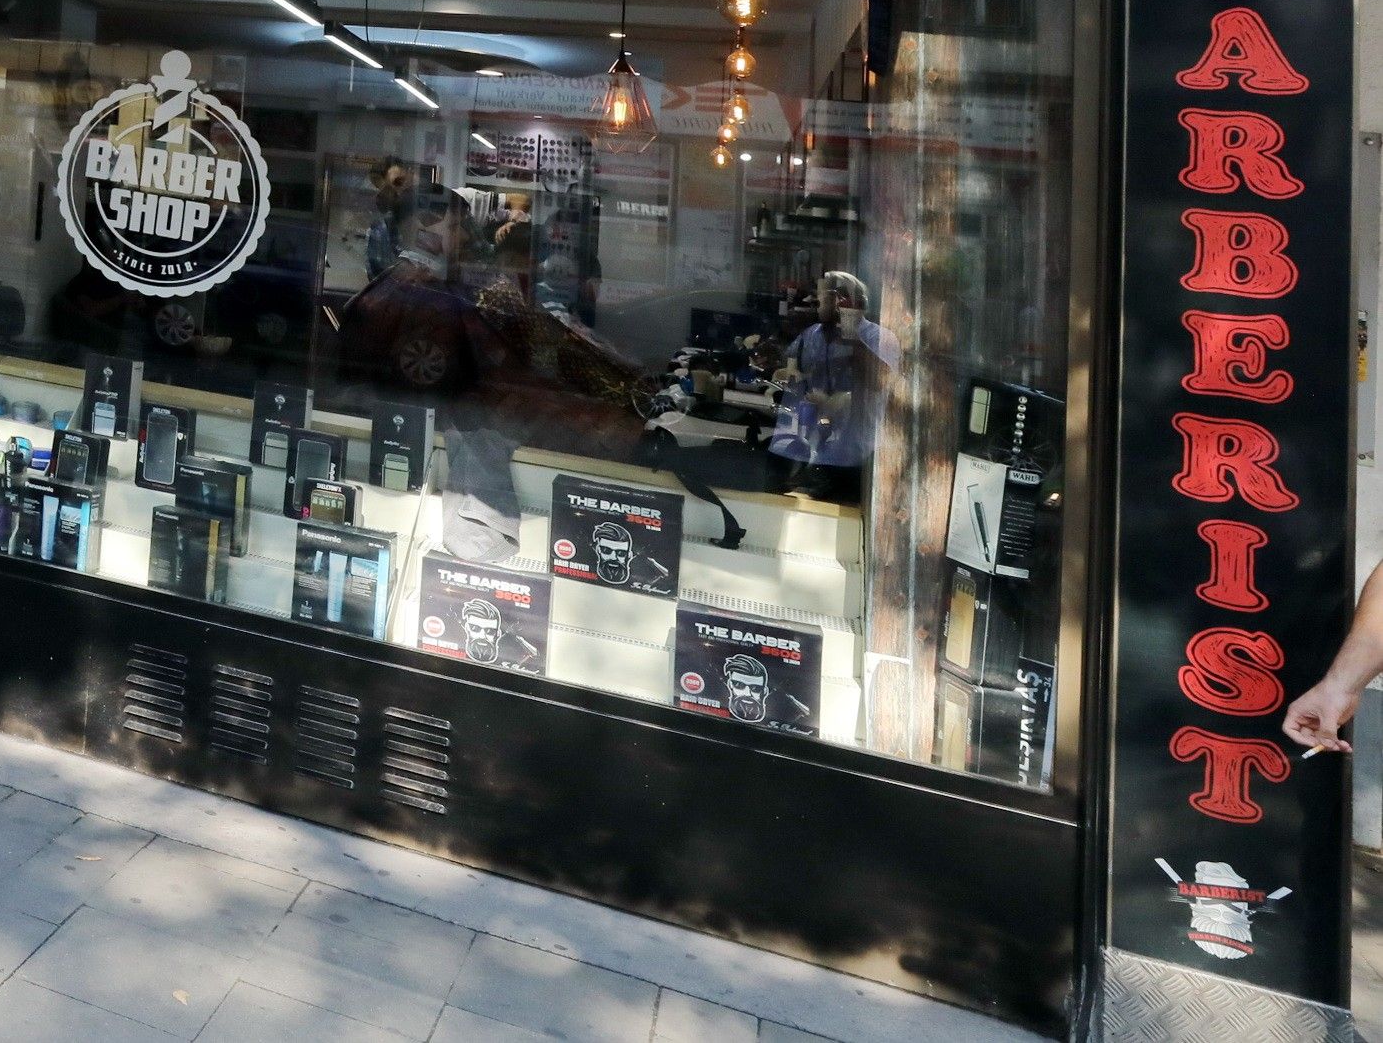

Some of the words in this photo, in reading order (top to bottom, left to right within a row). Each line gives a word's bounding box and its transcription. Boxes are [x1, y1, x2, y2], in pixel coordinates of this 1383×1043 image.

[85, 139, 243, 203] BARBER
[108, 188, 210, 243] SHOP
[117, 251, 153, 274] SINCE
[161, 261, 195, 275] 2018
[1012, 473, 1037, 483] WAHL
[567, 494, 597, 508] THE
[600, 500, 662, 520] BARBER
[301, 529, 342, 544] Panasonic
[437, 568, 468, 583] THE
[470, 575, 531, 595] BARBER
[694, 622, 729, 639] THE
[731, 629, 801, 653] BARBER
[1178, 881, 1266, 903] BARBERIST
